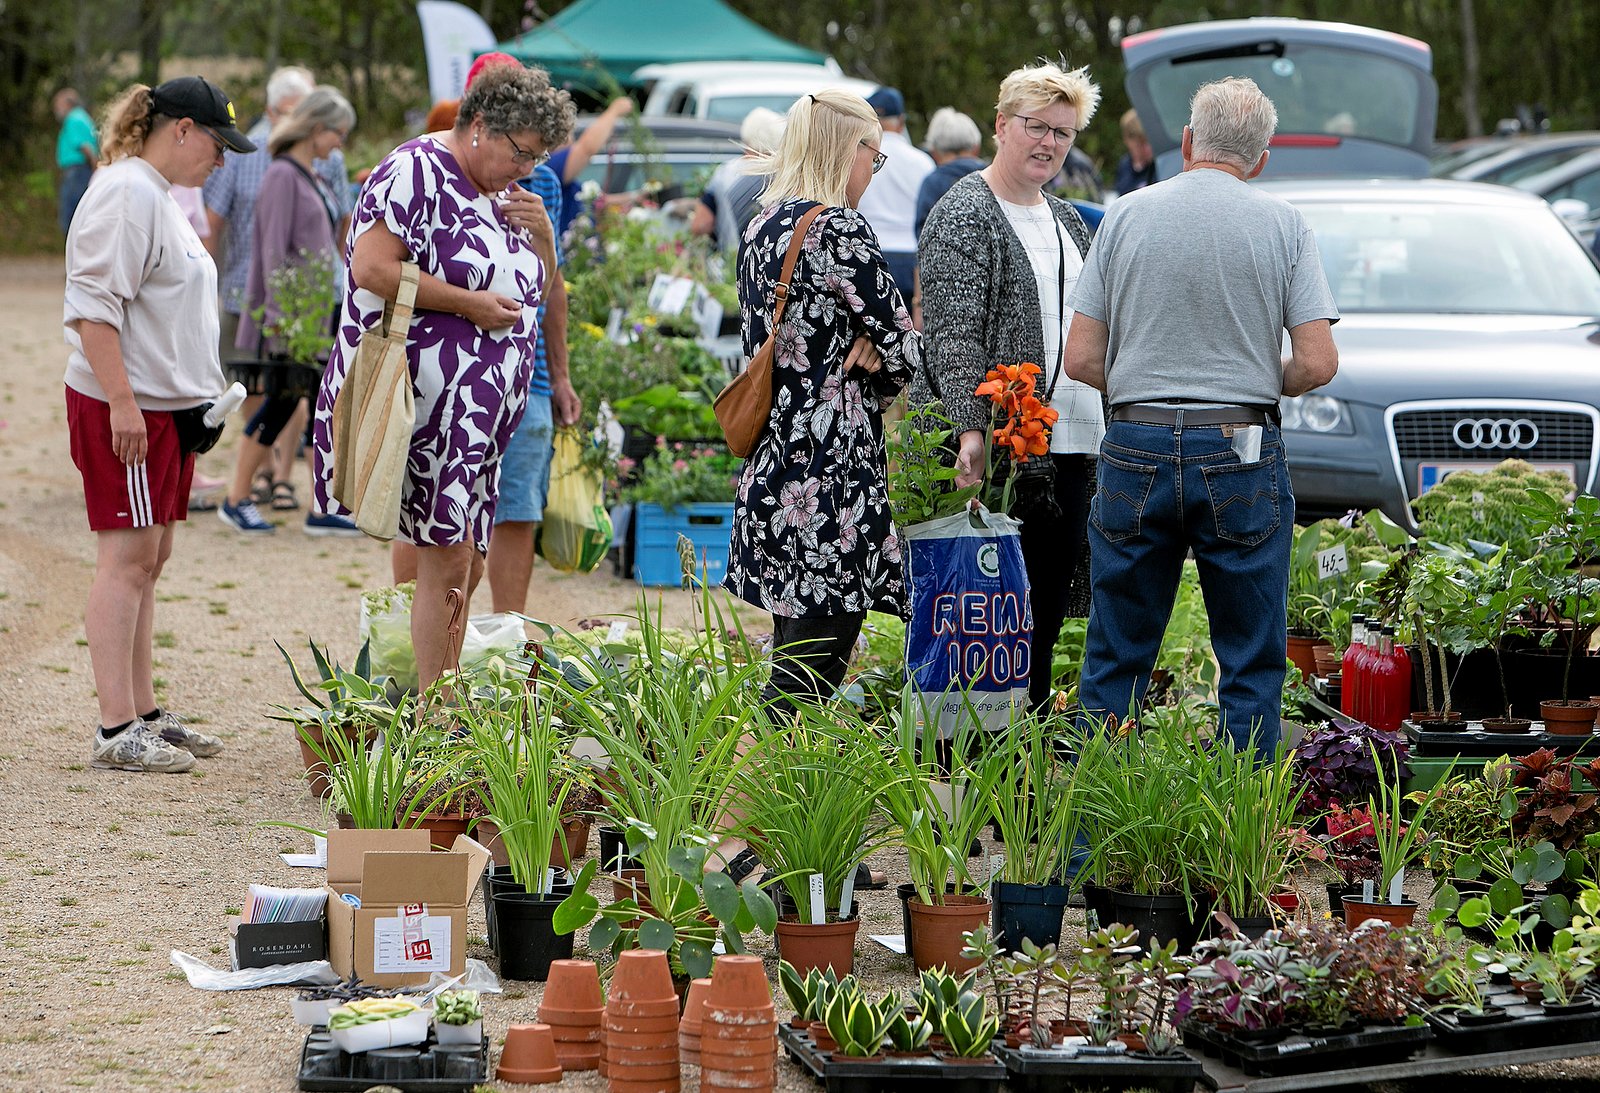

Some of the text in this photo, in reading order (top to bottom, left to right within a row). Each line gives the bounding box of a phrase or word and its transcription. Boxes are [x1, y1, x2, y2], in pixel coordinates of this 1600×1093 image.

[932, 591, 1034, 636] REMA
[947, 639, 1031, 684] 1000
[252, 943, 312, 952] ROSENDAHL
